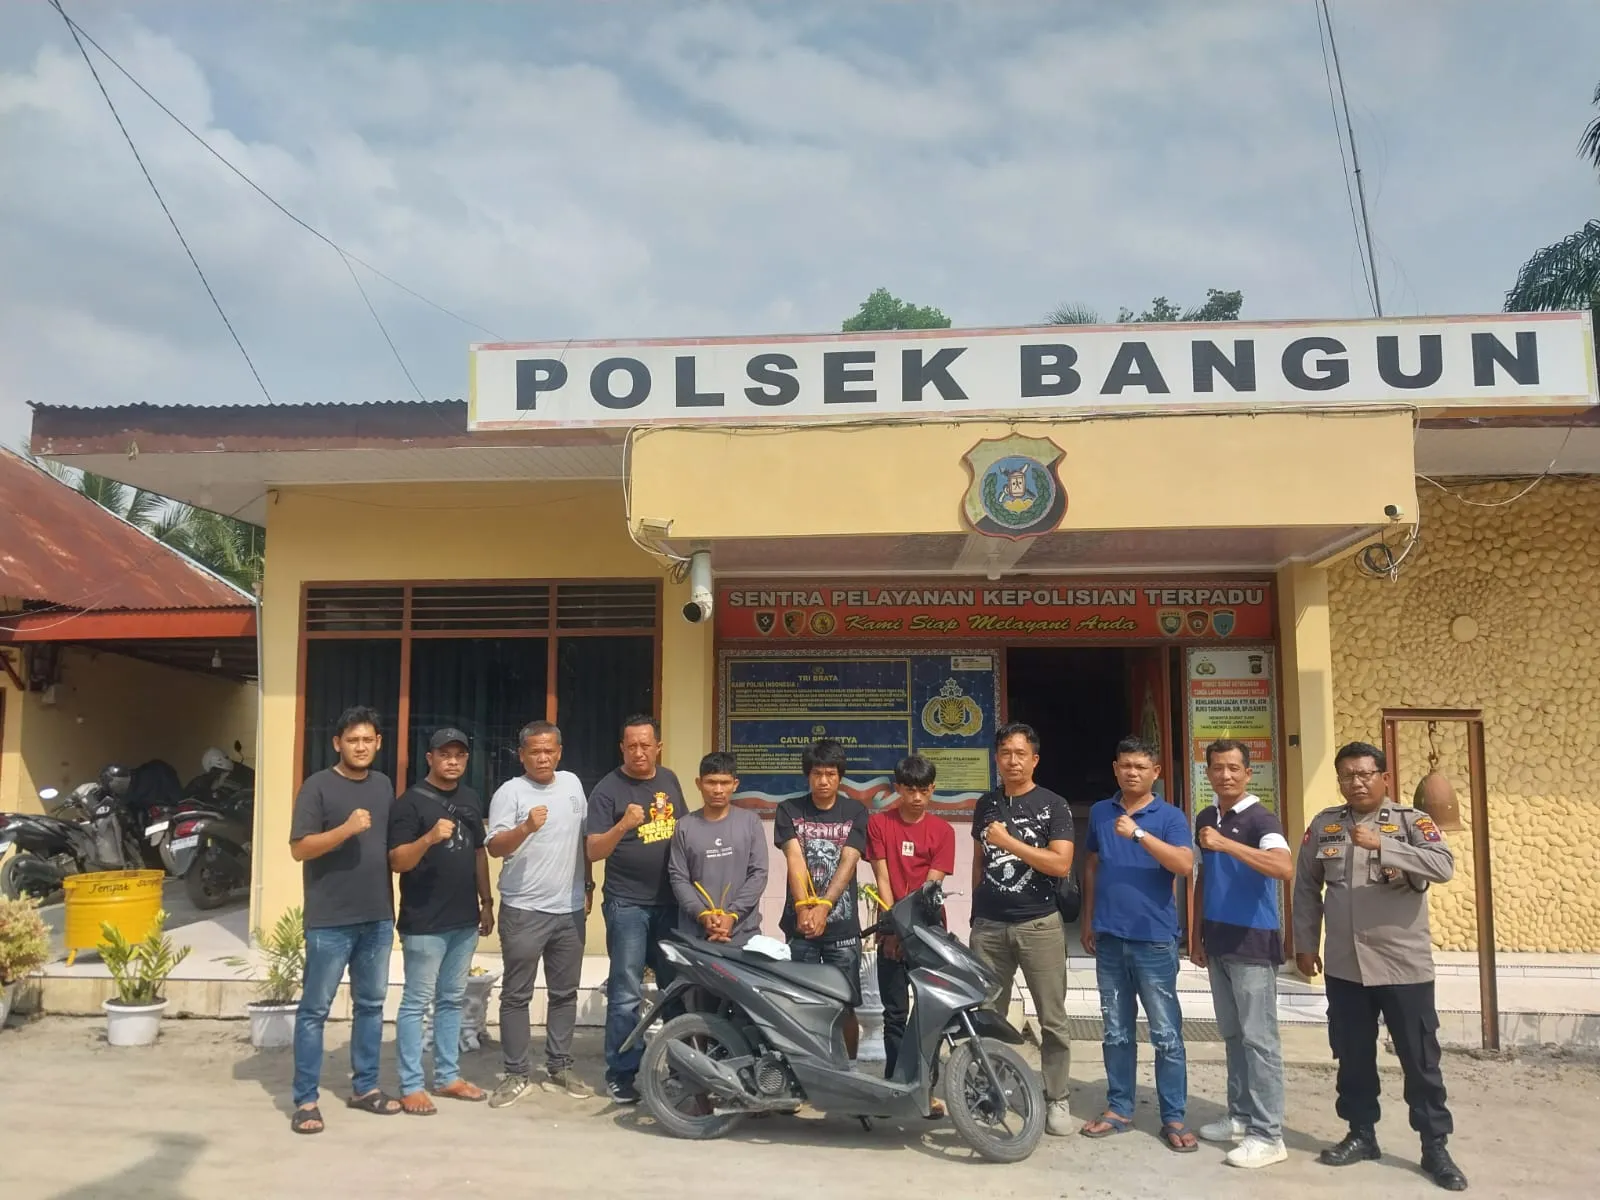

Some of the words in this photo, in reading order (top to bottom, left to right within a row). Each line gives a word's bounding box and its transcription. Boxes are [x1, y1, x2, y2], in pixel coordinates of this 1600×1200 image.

[516, 347, 969, 411] POLSEK
[1020, 331, 1540, 398] BANGUN
[728, 590, 825, 607] SENTRA
[831, 590, 975, 606] PELAYANAN
[983, 589, 1136, 605] KEPOLISIAN
[1144, 589, 1263, 605] TERPADU
[845, 615, 903, 631] Kami
[908, 615, 960, 633] Siap
[967, 615, 1071, 633] Melayani
[1076, 615, 1137, 631] Anda
[780, 736, 810, 744] CATUR
